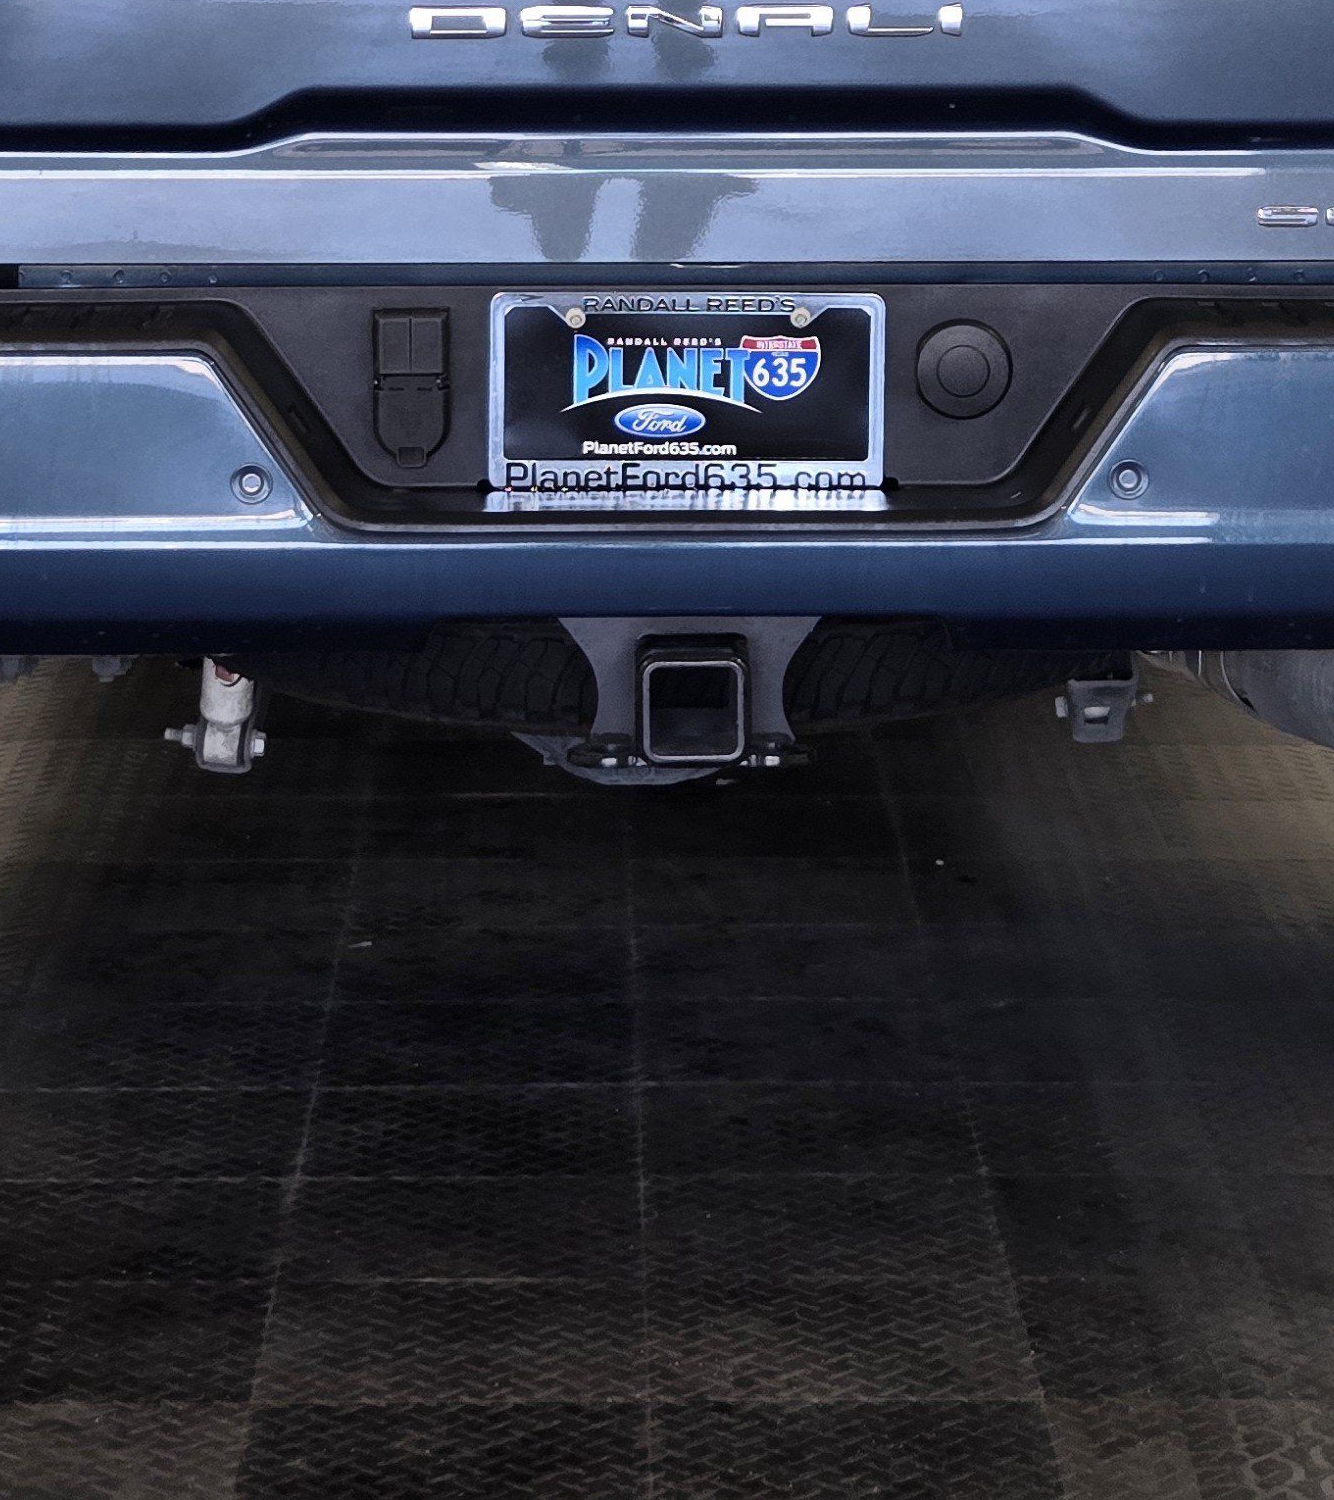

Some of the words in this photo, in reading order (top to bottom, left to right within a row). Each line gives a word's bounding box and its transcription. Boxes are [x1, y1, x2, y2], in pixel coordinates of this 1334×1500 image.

[409, 2, 963, 39] DENALI
[582, 296, 699, 313] RANDALL
[706, 295, 796, 313] REED'S
[573, 334, 750, 405] PLANET
[752, 357, 807, 387] 635
[630, 410, 687, 433] Ford
[582, 441, 737, 456] PlanetFord635.com
[505, 462, 867, 489] PlanetFord635com
